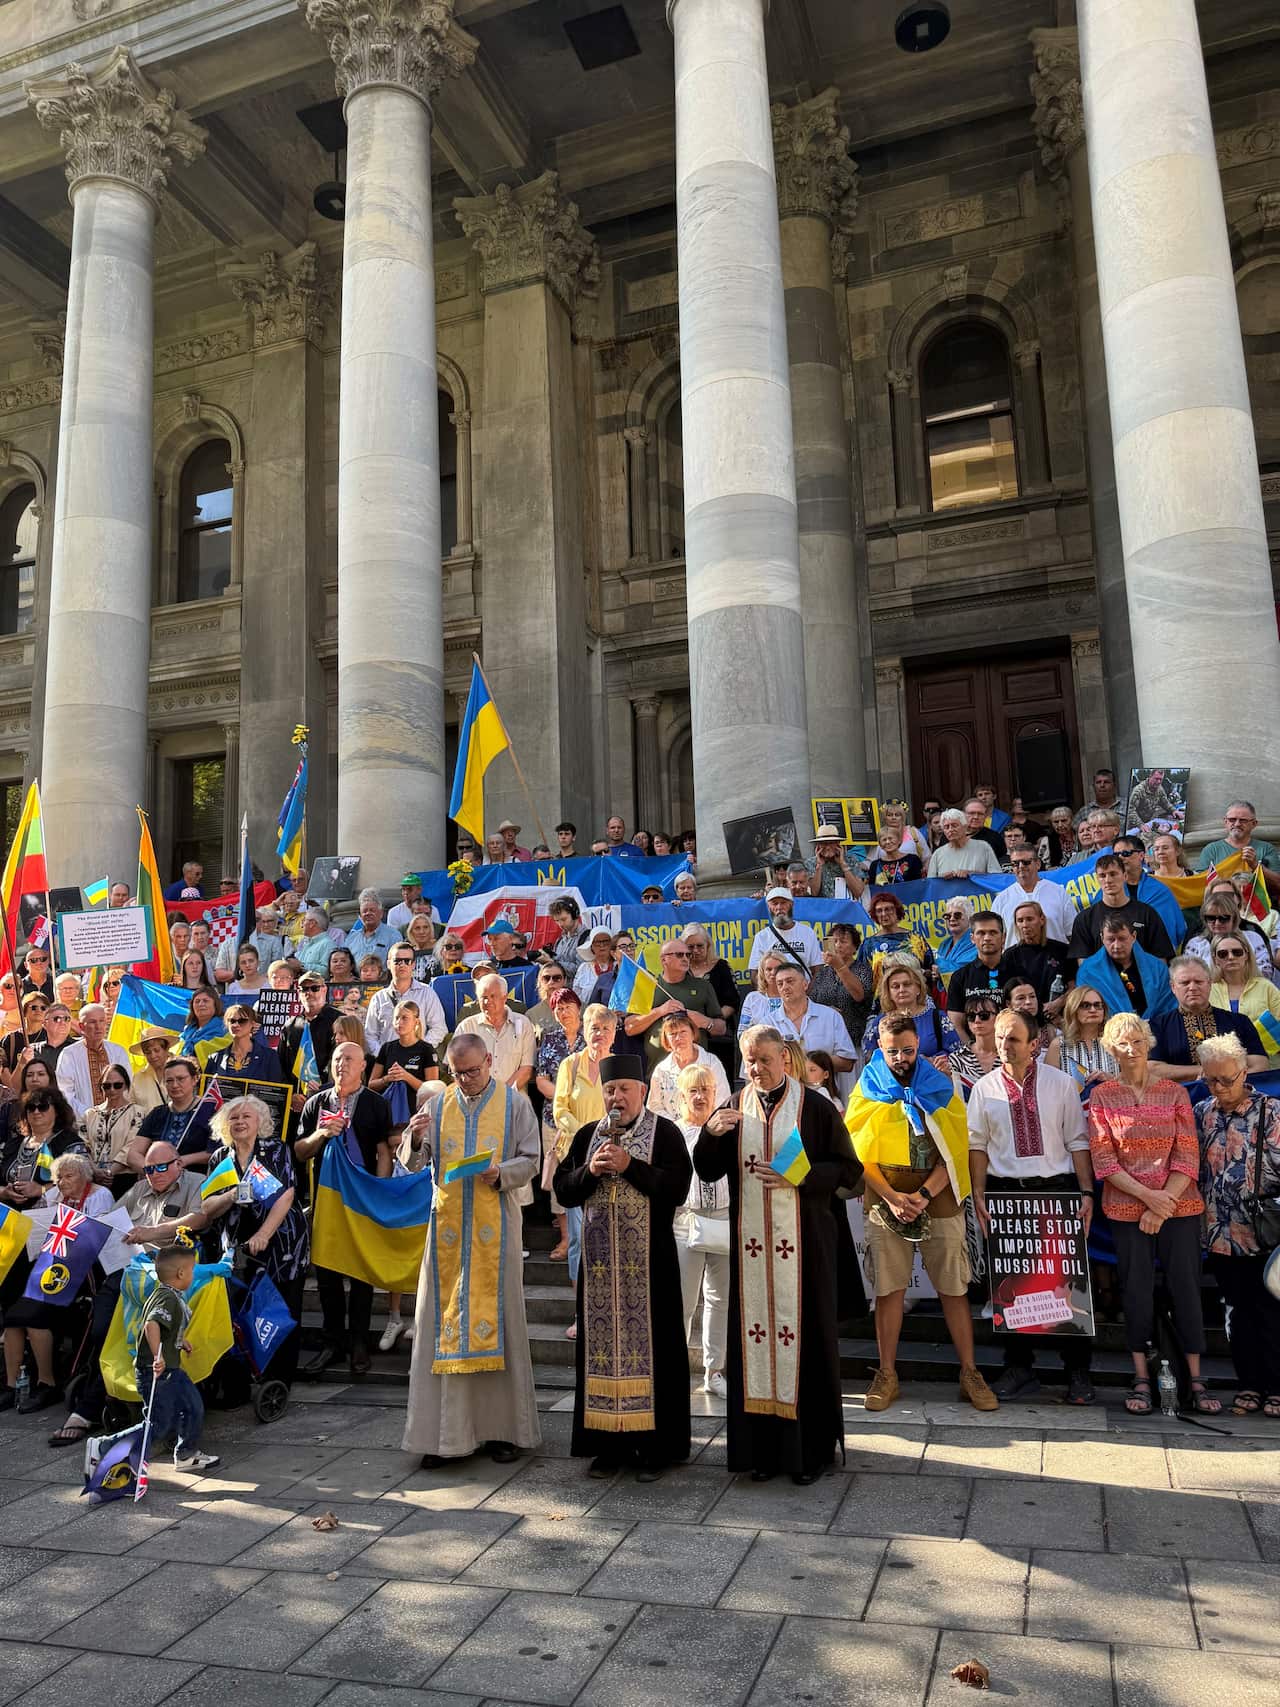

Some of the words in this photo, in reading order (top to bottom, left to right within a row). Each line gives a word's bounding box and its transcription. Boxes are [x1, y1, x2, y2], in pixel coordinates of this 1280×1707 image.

[260, 991, 301, 1002] AUSTRALI
[260, 1002, 290, 1013] PLEASE
[294, 1004, 304, 1014] ST
[988, 1199, 1063, 1215] AUSTRALIA
[990, 1218, 1040, 1235] PLEASE
[1046, 1219, 1082, 1236] STOP
[999, 1238, 1077, 1255] IMPORTING
[994, 1258, 1055, 1275] RUSSIAN
[1062, 1259, 1085, 1276] OIL
